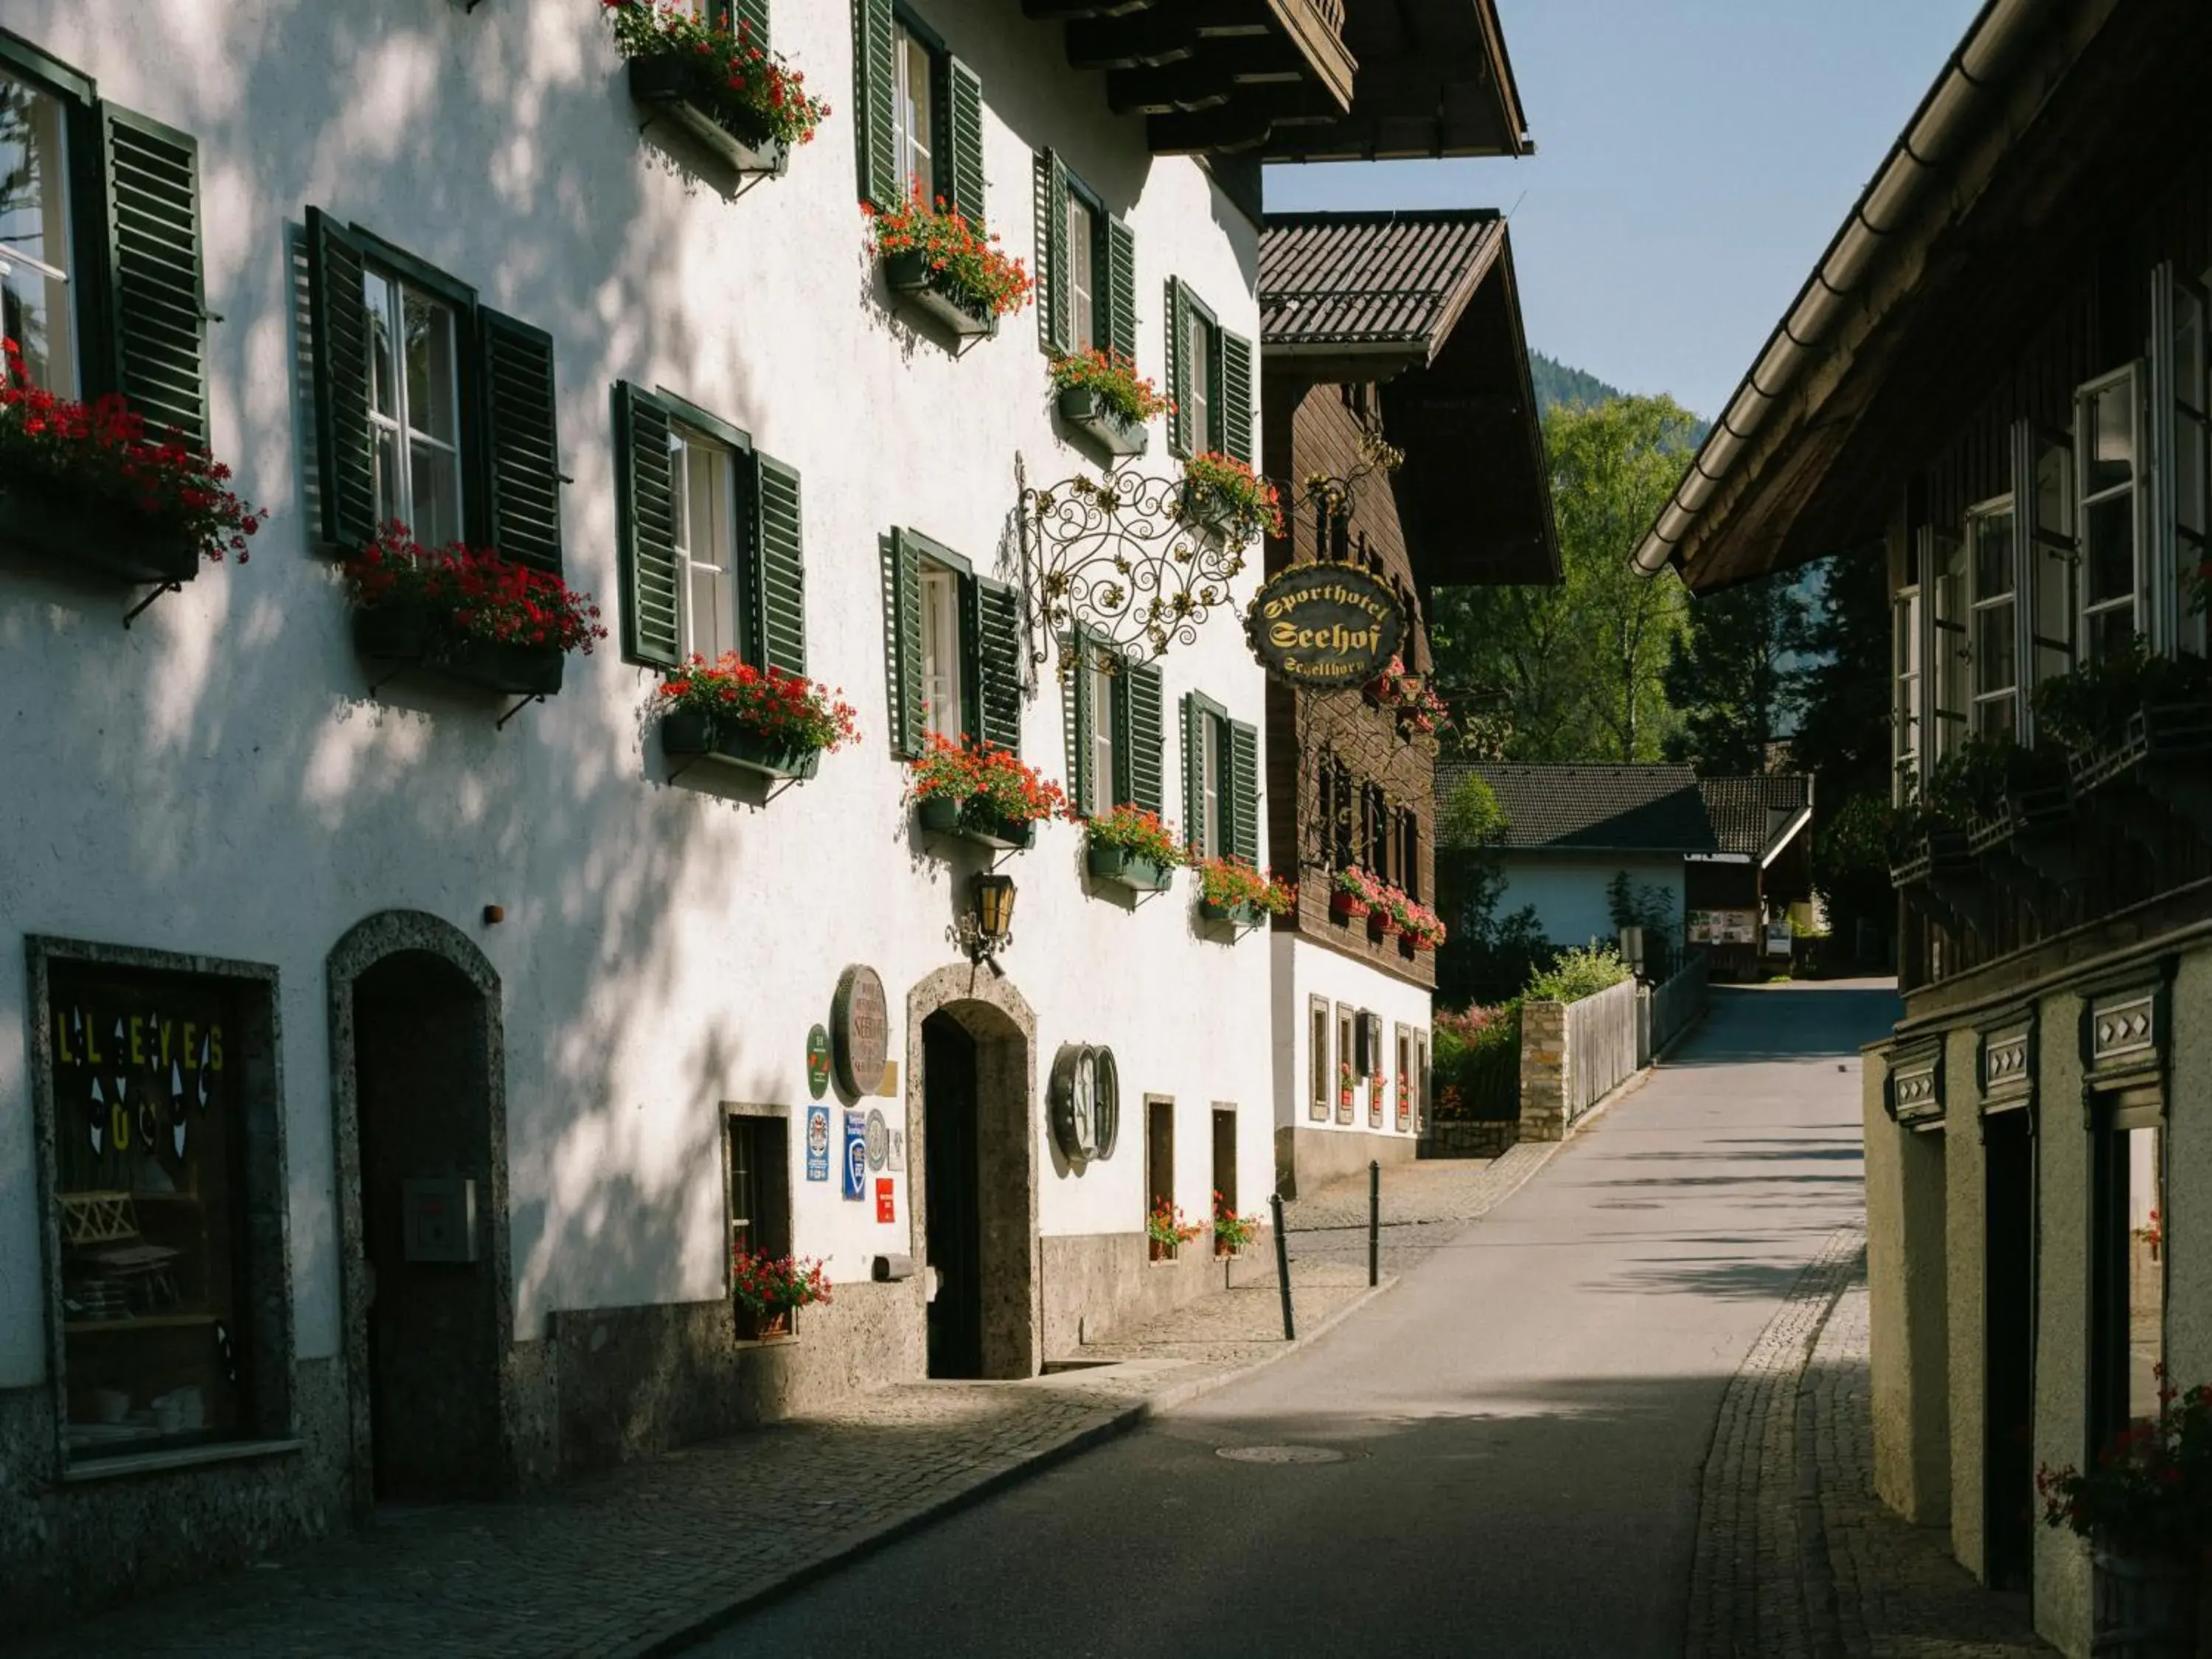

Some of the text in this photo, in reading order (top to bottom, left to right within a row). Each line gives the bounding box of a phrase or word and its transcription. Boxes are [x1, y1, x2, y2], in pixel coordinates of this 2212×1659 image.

[1264, 585, 1390, 620] Sporthotel
[1270, 622, 1381, 655] Seehof
[130, 1016, 223, 1071] EYES
